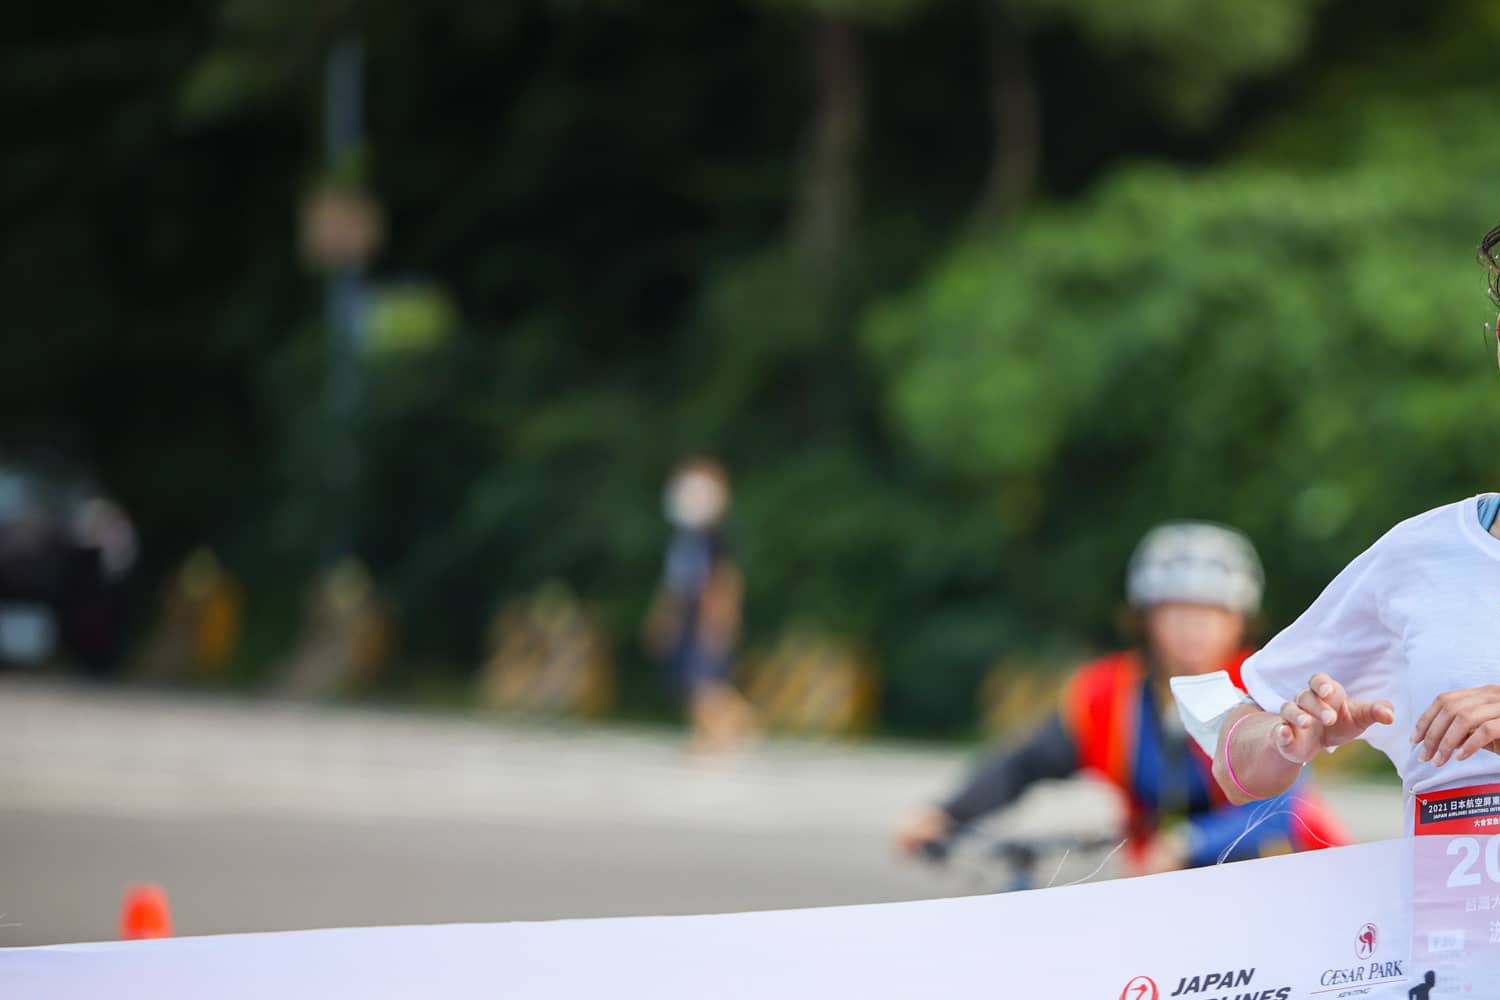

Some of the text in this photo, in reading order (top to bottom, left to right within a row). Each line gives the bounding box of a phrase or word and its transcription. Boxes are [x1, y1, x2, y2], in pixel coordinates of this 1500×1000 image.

[1428, 803, 1447, 814] 2021
[1368, 960, 1404, 980] PARK
[1171, 968, 1255, 997] JAPAN
